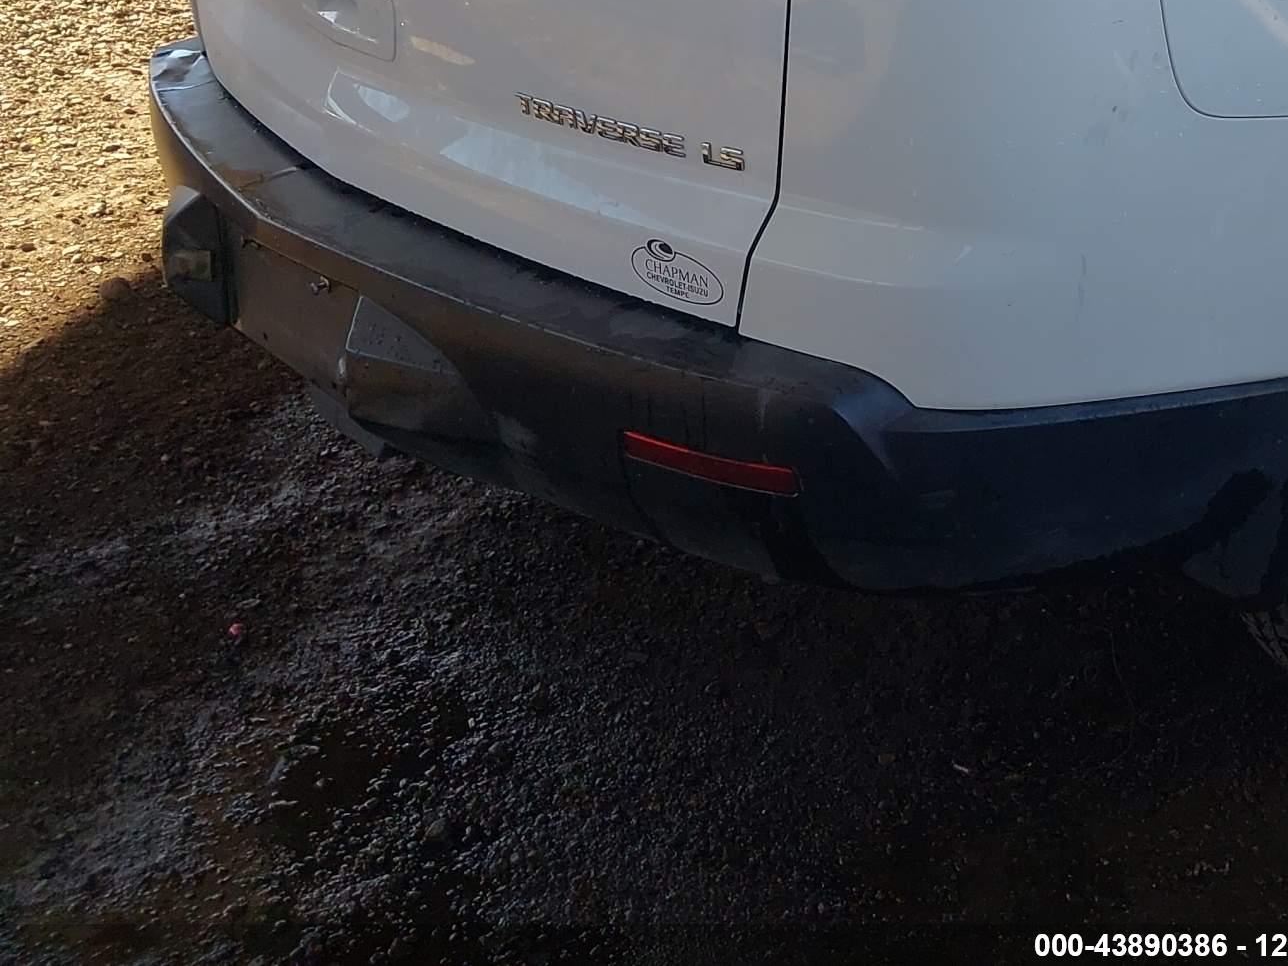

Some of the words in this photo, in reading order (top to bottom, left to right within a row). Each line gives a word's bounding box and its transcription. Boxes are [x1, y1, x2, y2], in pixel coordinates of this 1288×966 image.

[515, 92, 686, 158] TRAVERSE
[701, 141, 745, 171] LS
[645, 259, 708, 288] CHAPMAN
